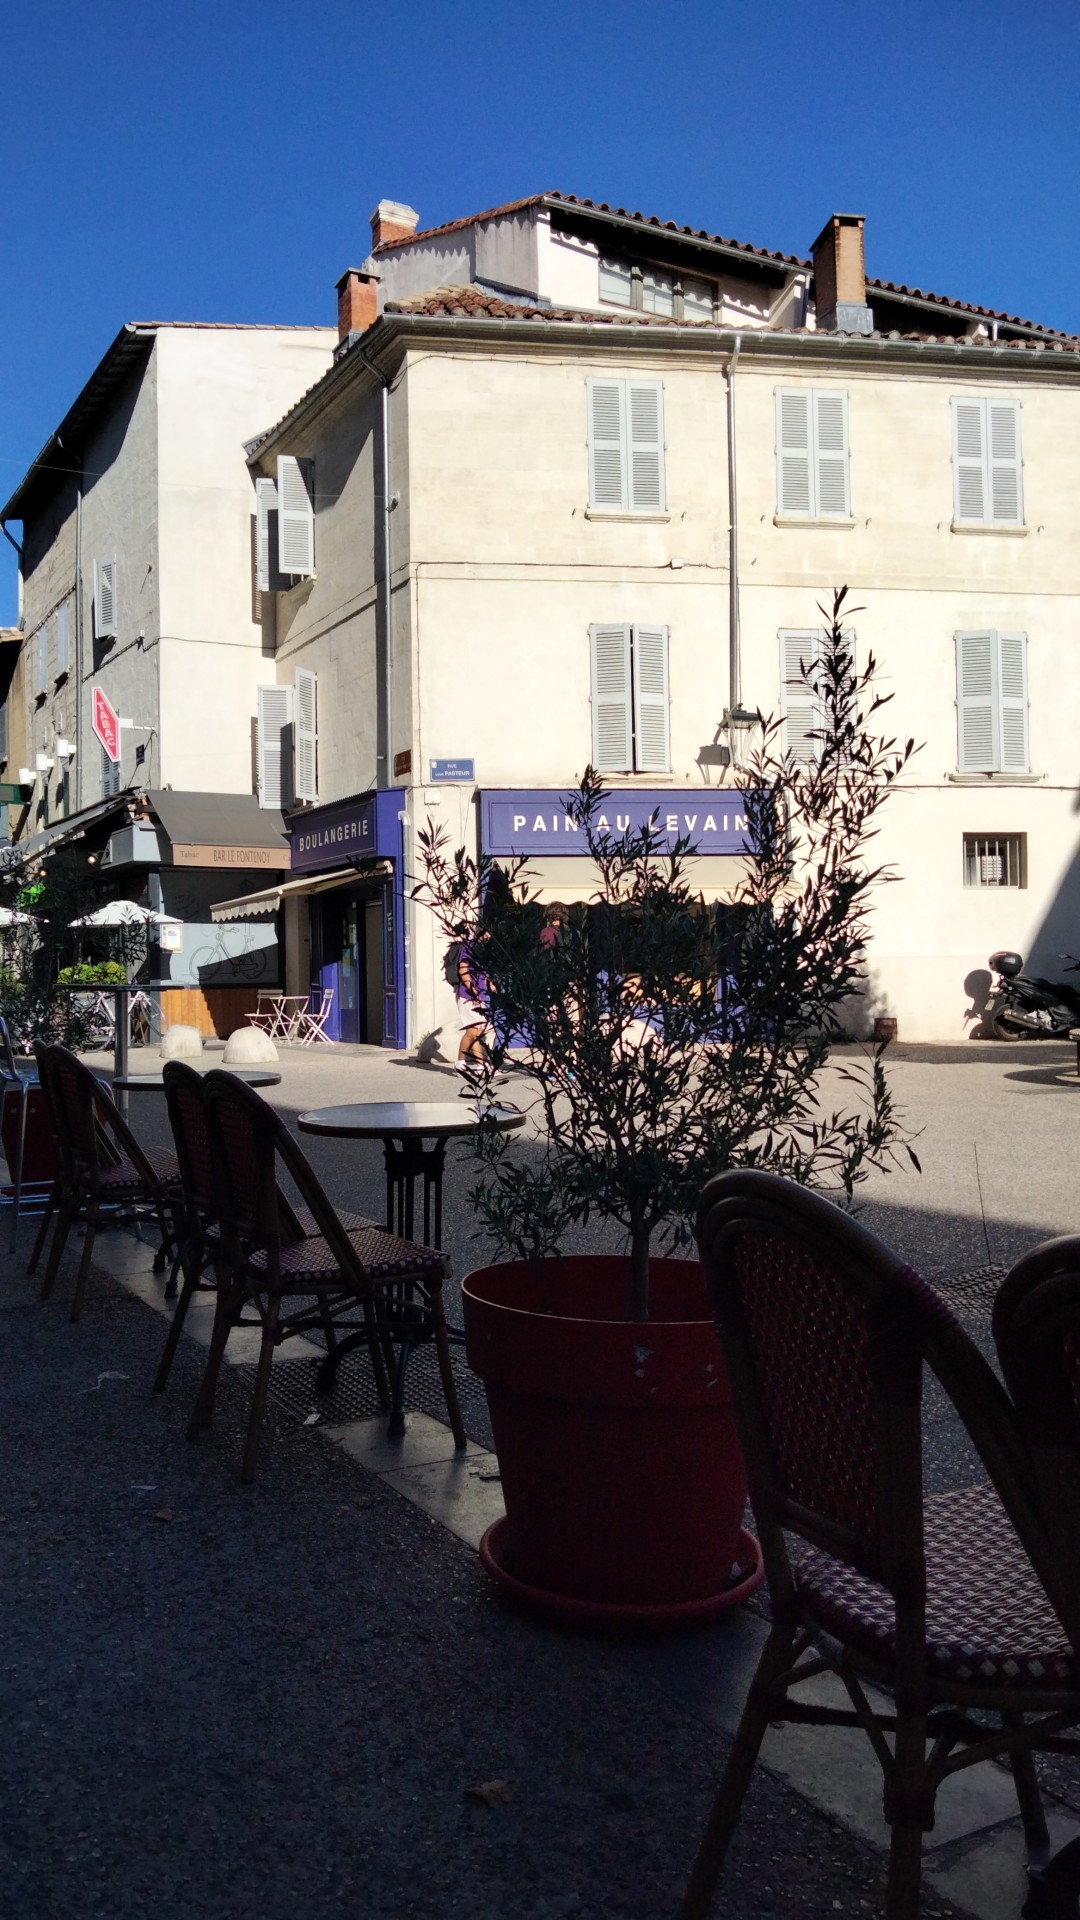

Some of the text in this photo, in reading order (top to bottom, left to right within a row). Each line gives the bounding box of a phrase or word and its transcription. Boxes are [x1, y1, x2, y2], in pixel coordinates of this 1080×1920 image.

[97, 702, 115, 745] TABAC
[513, 815, 749, 832] PAIN AU LEVAIN
[299, 819, 368, 851] BOULANGERIE
[180, 850, 199, 858] Tabac
[213, 850, 271, 863] BAR LE FONTENOY
